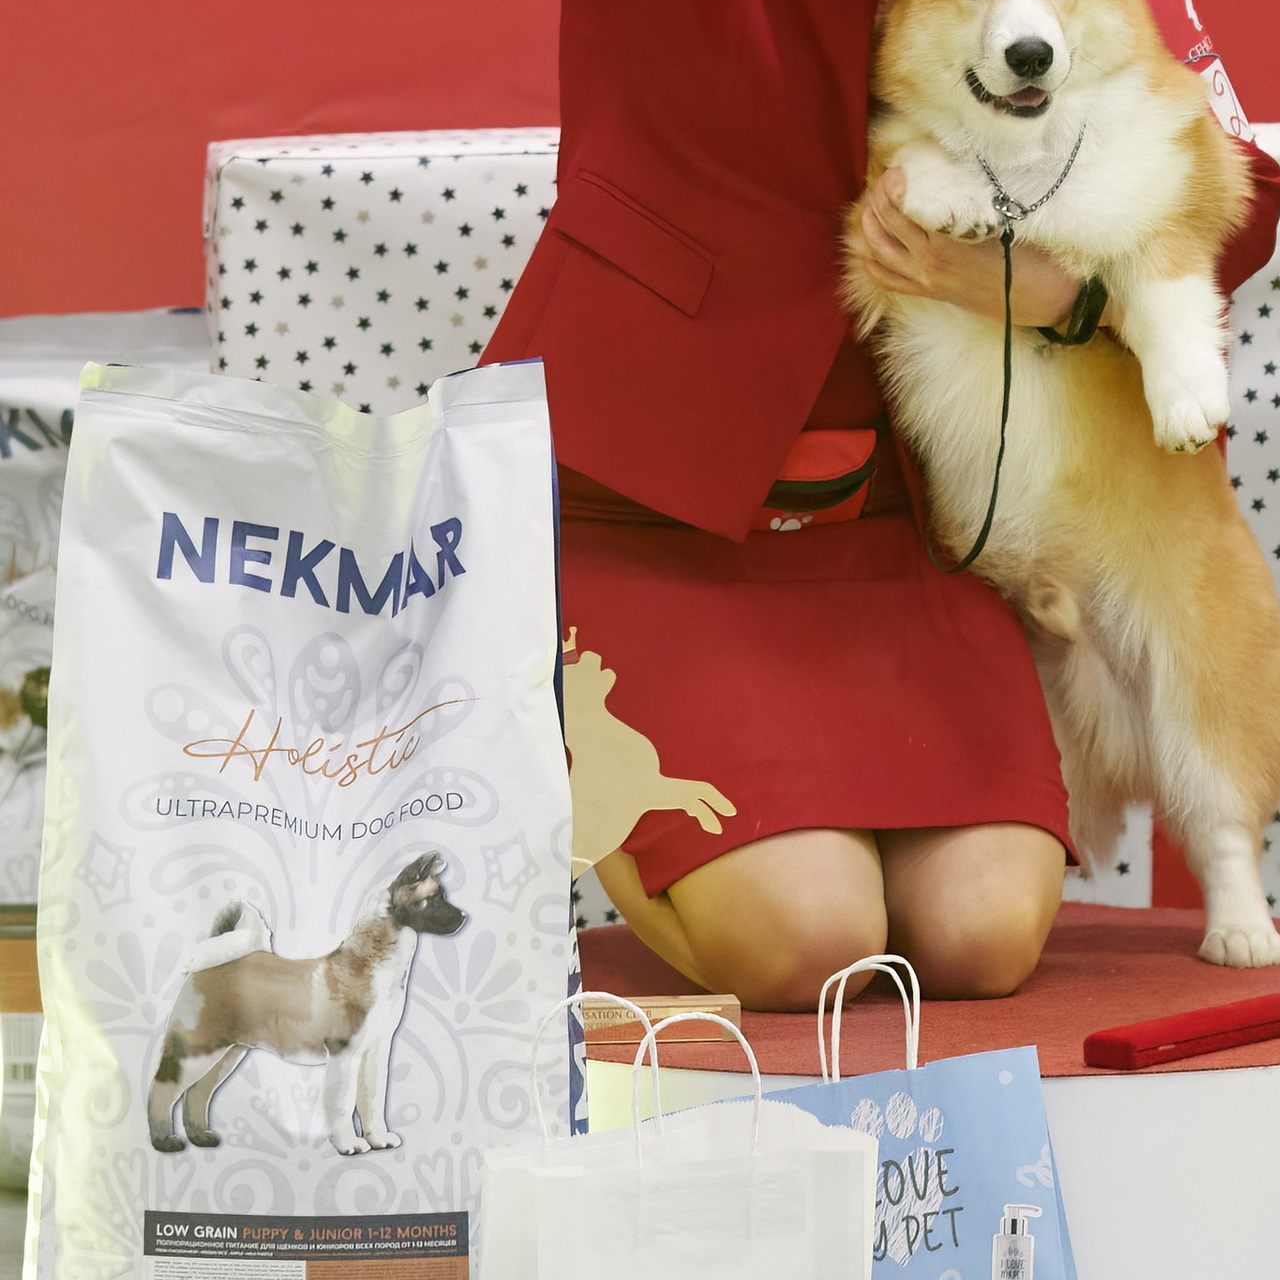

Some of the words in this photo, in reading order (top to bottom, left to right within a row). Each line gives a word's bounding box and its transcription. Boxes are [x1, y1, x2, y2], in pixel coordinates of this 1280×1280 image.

[156, 511, 467, 619] NEKMAR
[183, 698, 482, 787] Holistic
[156, 797, 342, 841] ULTRAPREMIUM
[351, 810, 395, 840] DOG
[399, 792, 464, 822] FOOD
[584, 1010, 622, 1020] SATION
[626, 1010, 653, 1019] CLB
[876, 1148, 960, 1208] OVE
[156, 1223, 190, 1237] LOW
[194, 1225, 238, 1239] GRAIN
[242, 1227, 289, 1240] PUPPY
[293, 1228, 304, 1240] &
[309, 1227, 362, 1240] JUNIOR
[367, 1227, 392, 1239] 1-12
[396, 1224, 457, 1239] MONTHS
[225, 1242, 259, 1250] ПИТАНИЕ
[260, 1243, 275, 1251] ДЛЯ
[276, 1243, 308, 1251] ЩЕНКОВ
[316, 1243, 354, 1251] ЮНИОРОВ
[374, 1241, 401, 1250] ПОРОД
[424, 1239, 457, 1248] МЕСЯЦЕВ
[873, 1220, 888, 1261] Y
[902, 1206, 964, 1256] PET
[1006, 1258, 1026, 1270] LOVE
